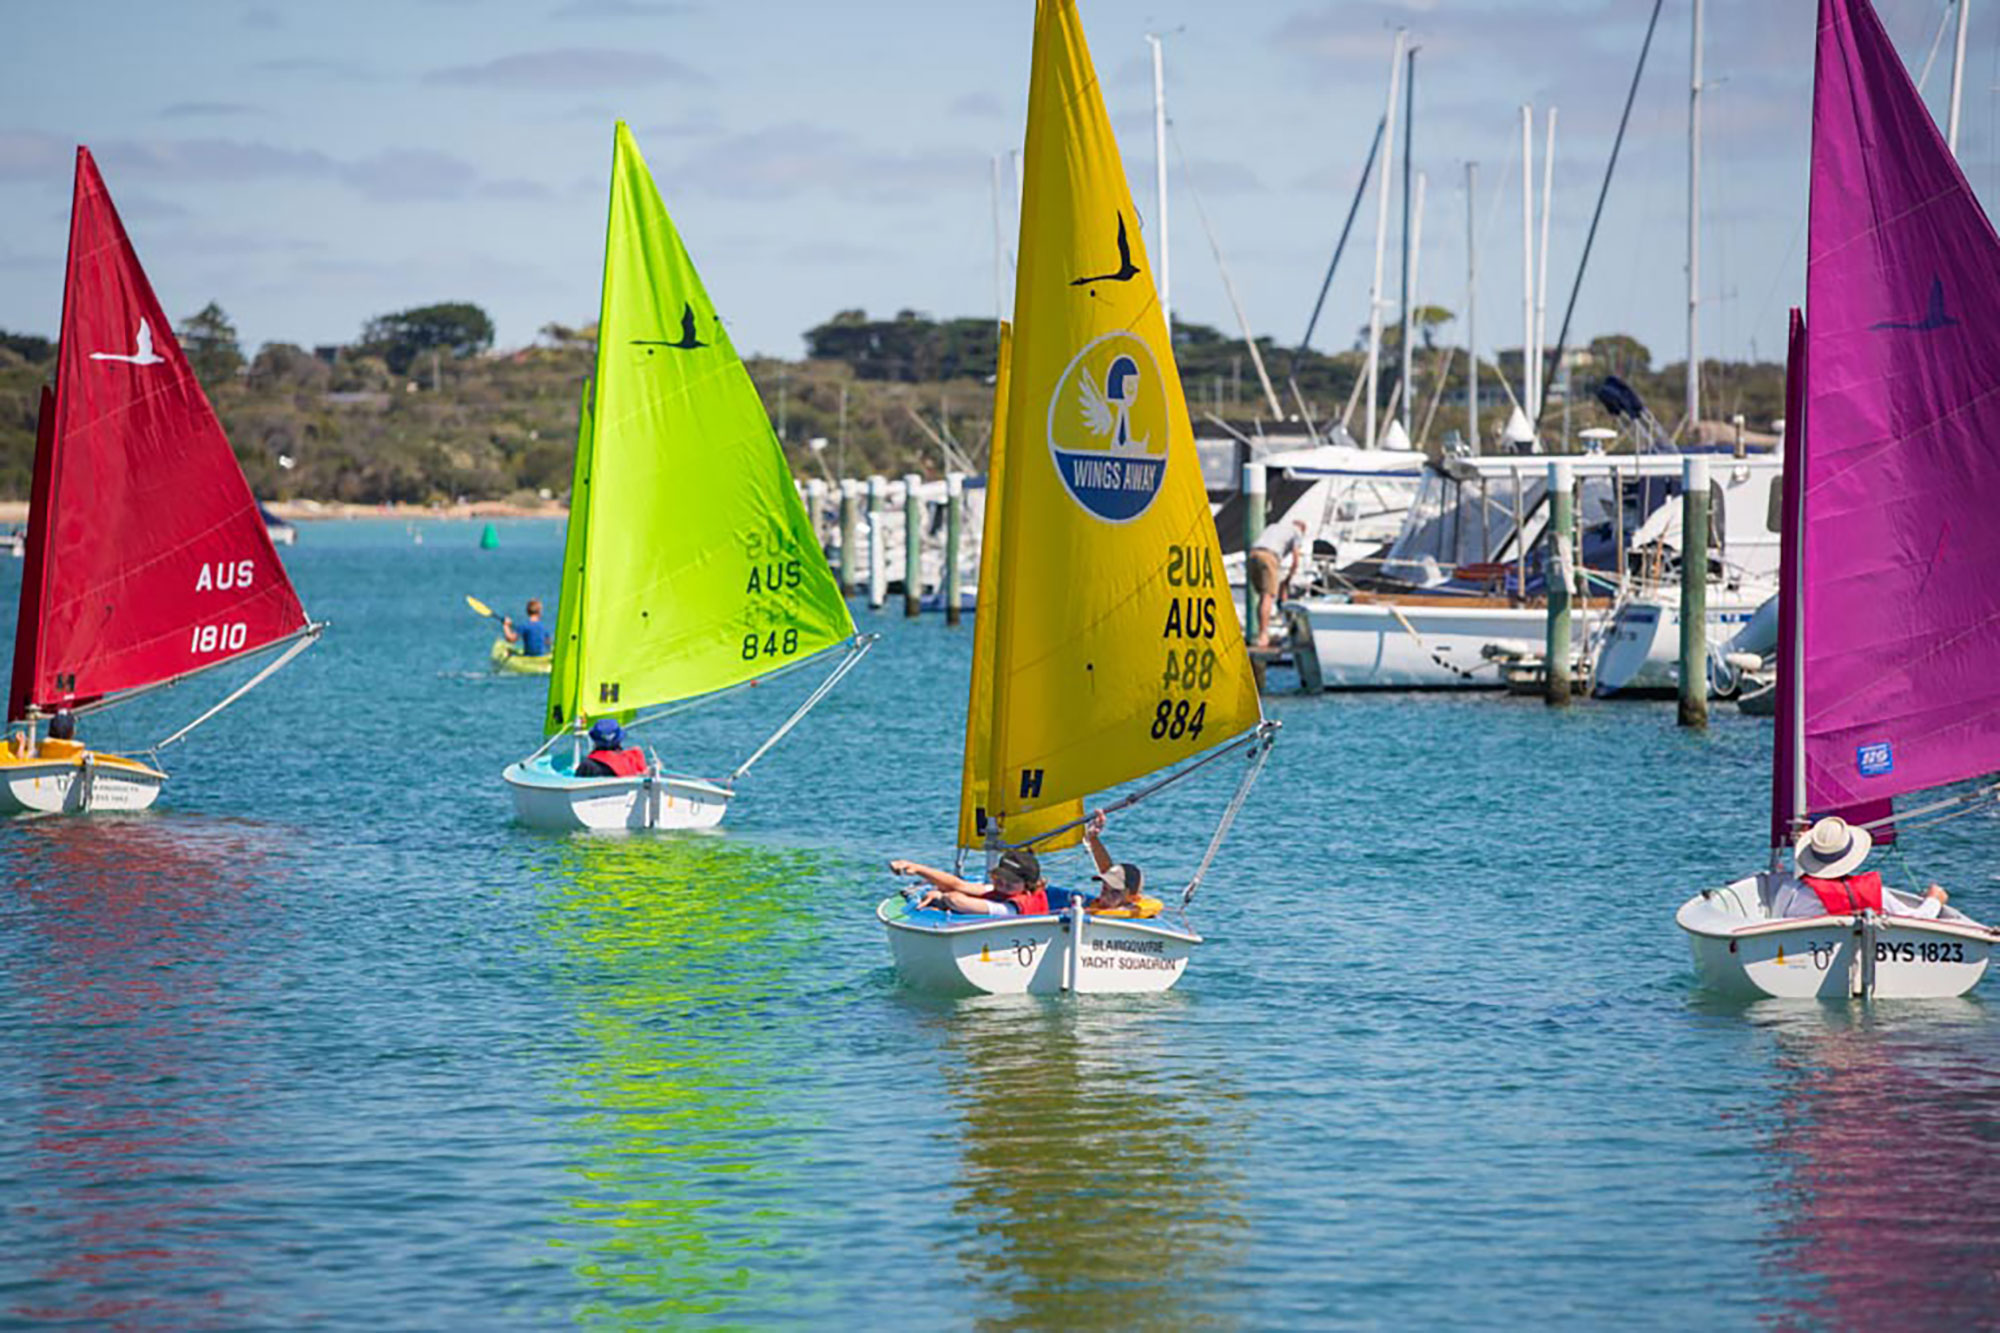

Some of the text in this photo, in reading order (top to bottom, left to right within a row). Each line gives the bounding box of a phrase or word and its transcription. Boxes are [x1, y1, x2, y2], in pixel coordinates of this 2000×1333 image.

[1074, 459, 1157, 491] WINGS AWAY
[195, 560, 254, 592] AUS
[746, 561, 802, 594] AUS
[1163, 598, 1216, 640] AUS
[191, 622, 247, 653] 1810
[742, 628, 798, 660] 848
[600, 683, 619, 704] H
[1151, 699, 1206, 741] 884
[1020, 769, 1044, 798] H
[1080, 956, 1176, 970] YACHT SQUADRON
[1875, 943, 1964, 963] BYS 1823
